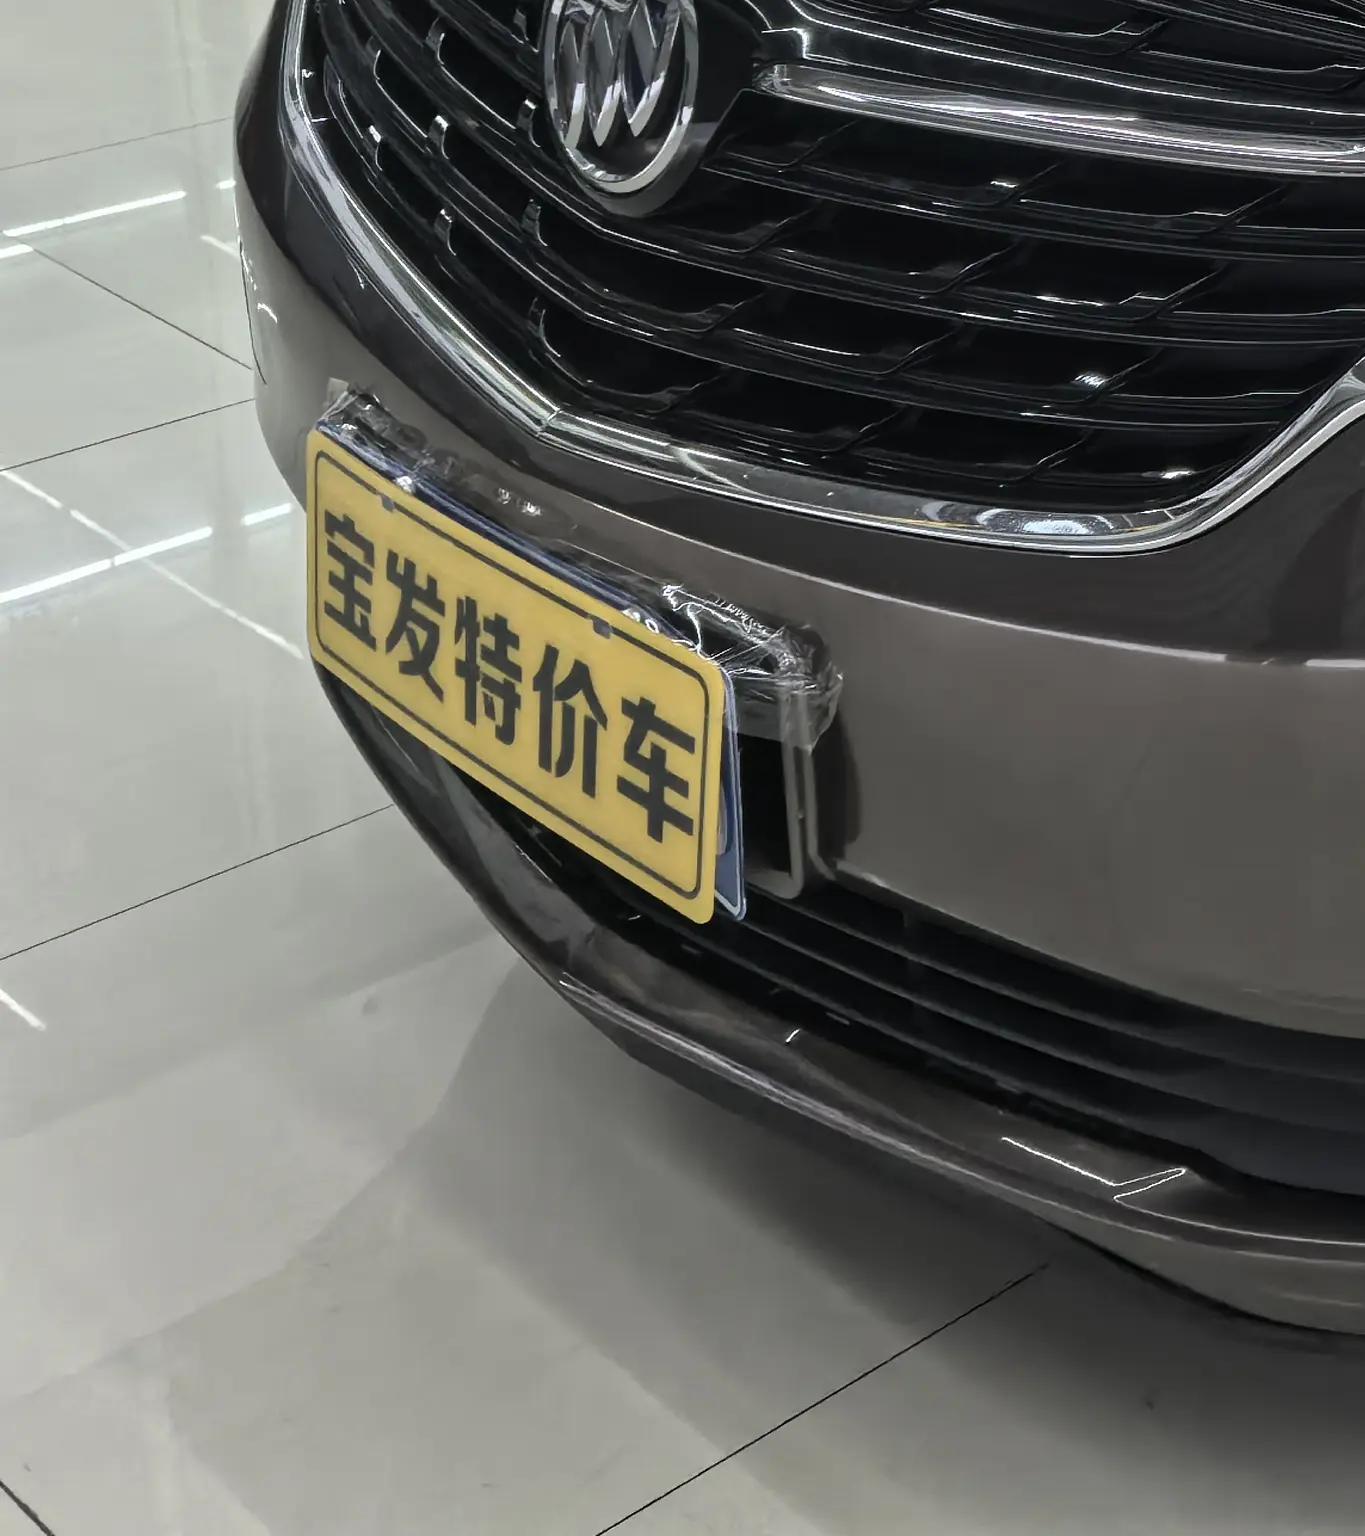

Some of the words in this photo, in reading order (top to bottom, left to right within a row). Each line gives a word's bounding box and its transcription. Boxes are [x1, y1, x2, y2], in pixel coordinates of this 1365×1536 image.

[323, 511, 697, 846] 宝发特价车
